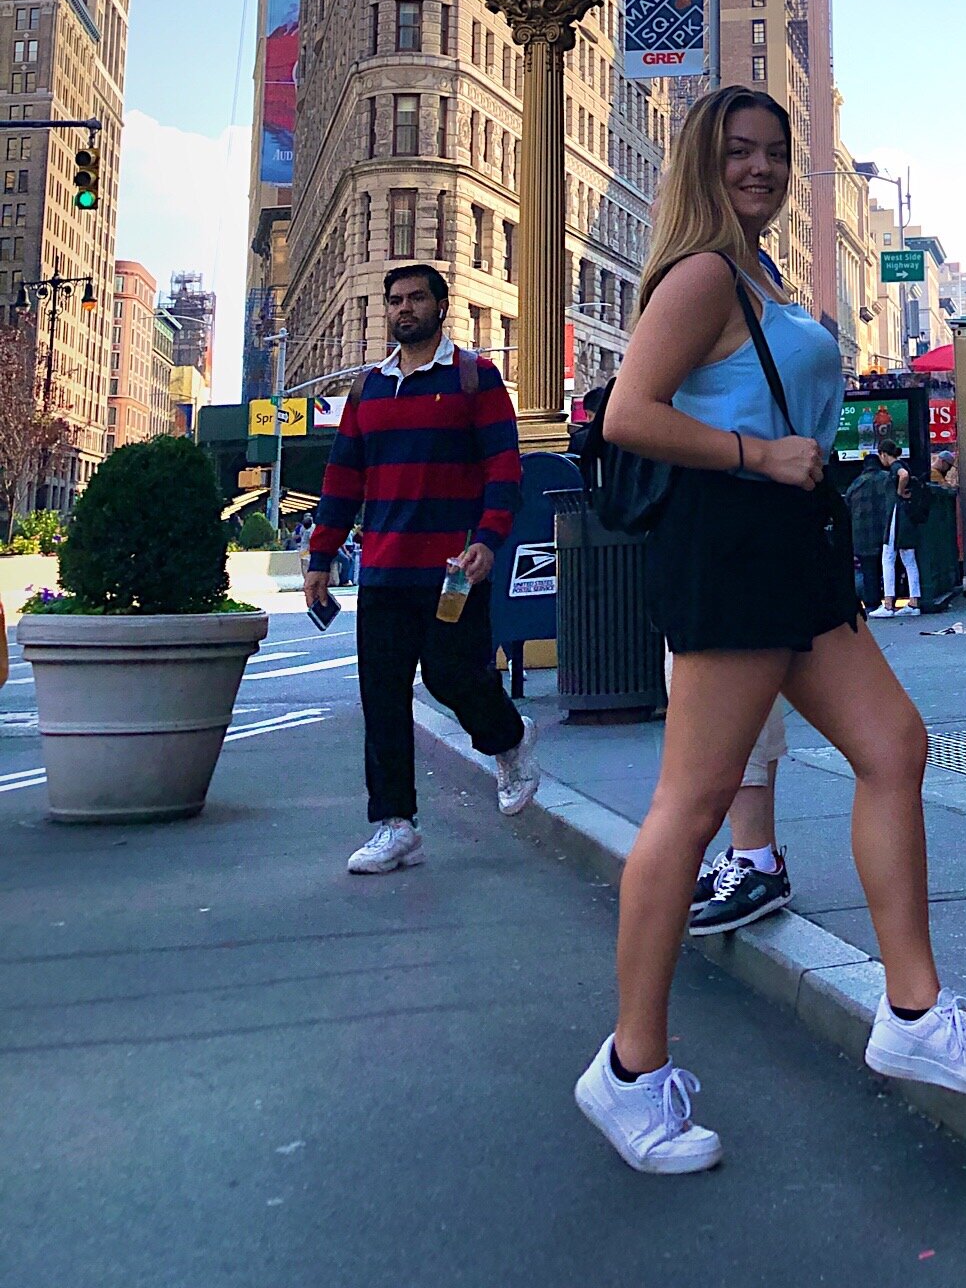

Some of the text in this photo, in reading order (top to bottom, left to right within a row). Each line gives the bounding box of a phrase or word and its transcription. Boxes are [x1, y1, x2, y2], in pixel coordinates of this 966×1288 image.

[641, 16, 675, 44] SQ.
[672, 18, 704, 46] PK.
[642, 51, 686, 65] GREY
[883, 253, 922, 261] West Side
[886, 262, 919, 271] Highway
[256, 413, 275, 426] Spr
